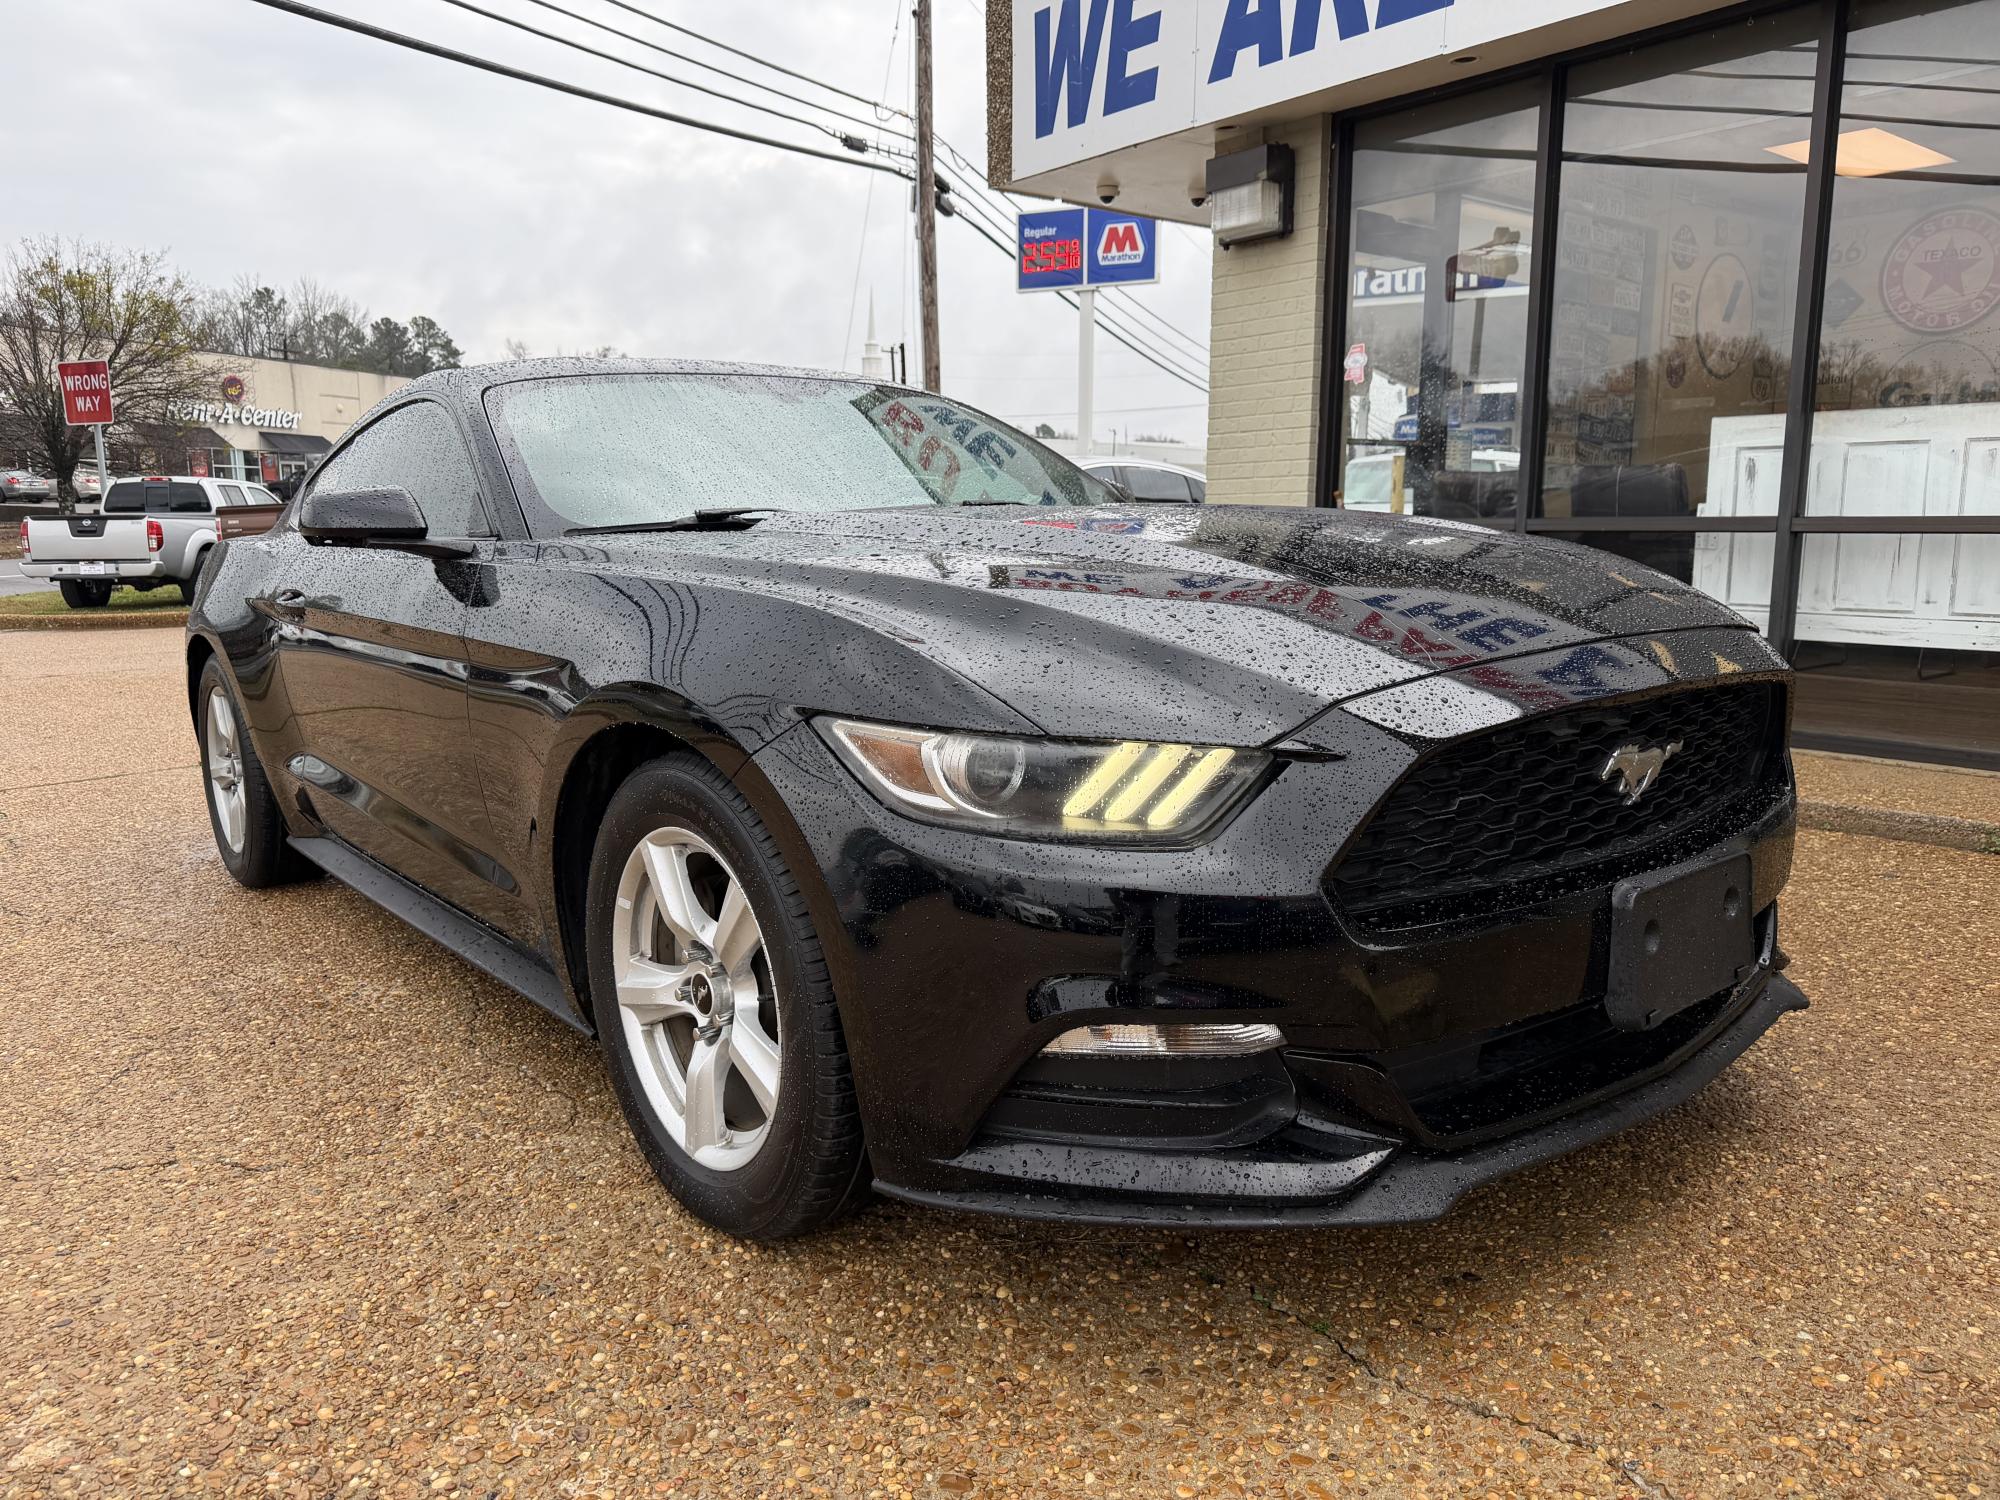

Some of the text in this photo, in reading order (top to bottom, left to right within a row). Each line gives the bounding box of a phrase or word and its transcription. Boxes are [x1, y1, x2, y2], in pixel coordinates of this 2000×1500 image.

[1035, 0, 1163, 139] WE
[1024, 226, 1057, 239] Regular
[1101, 253, 1141, 262] Marathon
[1923, 245, 1982, 262] TEXACO
[63, 373, 108, 392] WRONG
[75, 396, 101, 412] WAY
